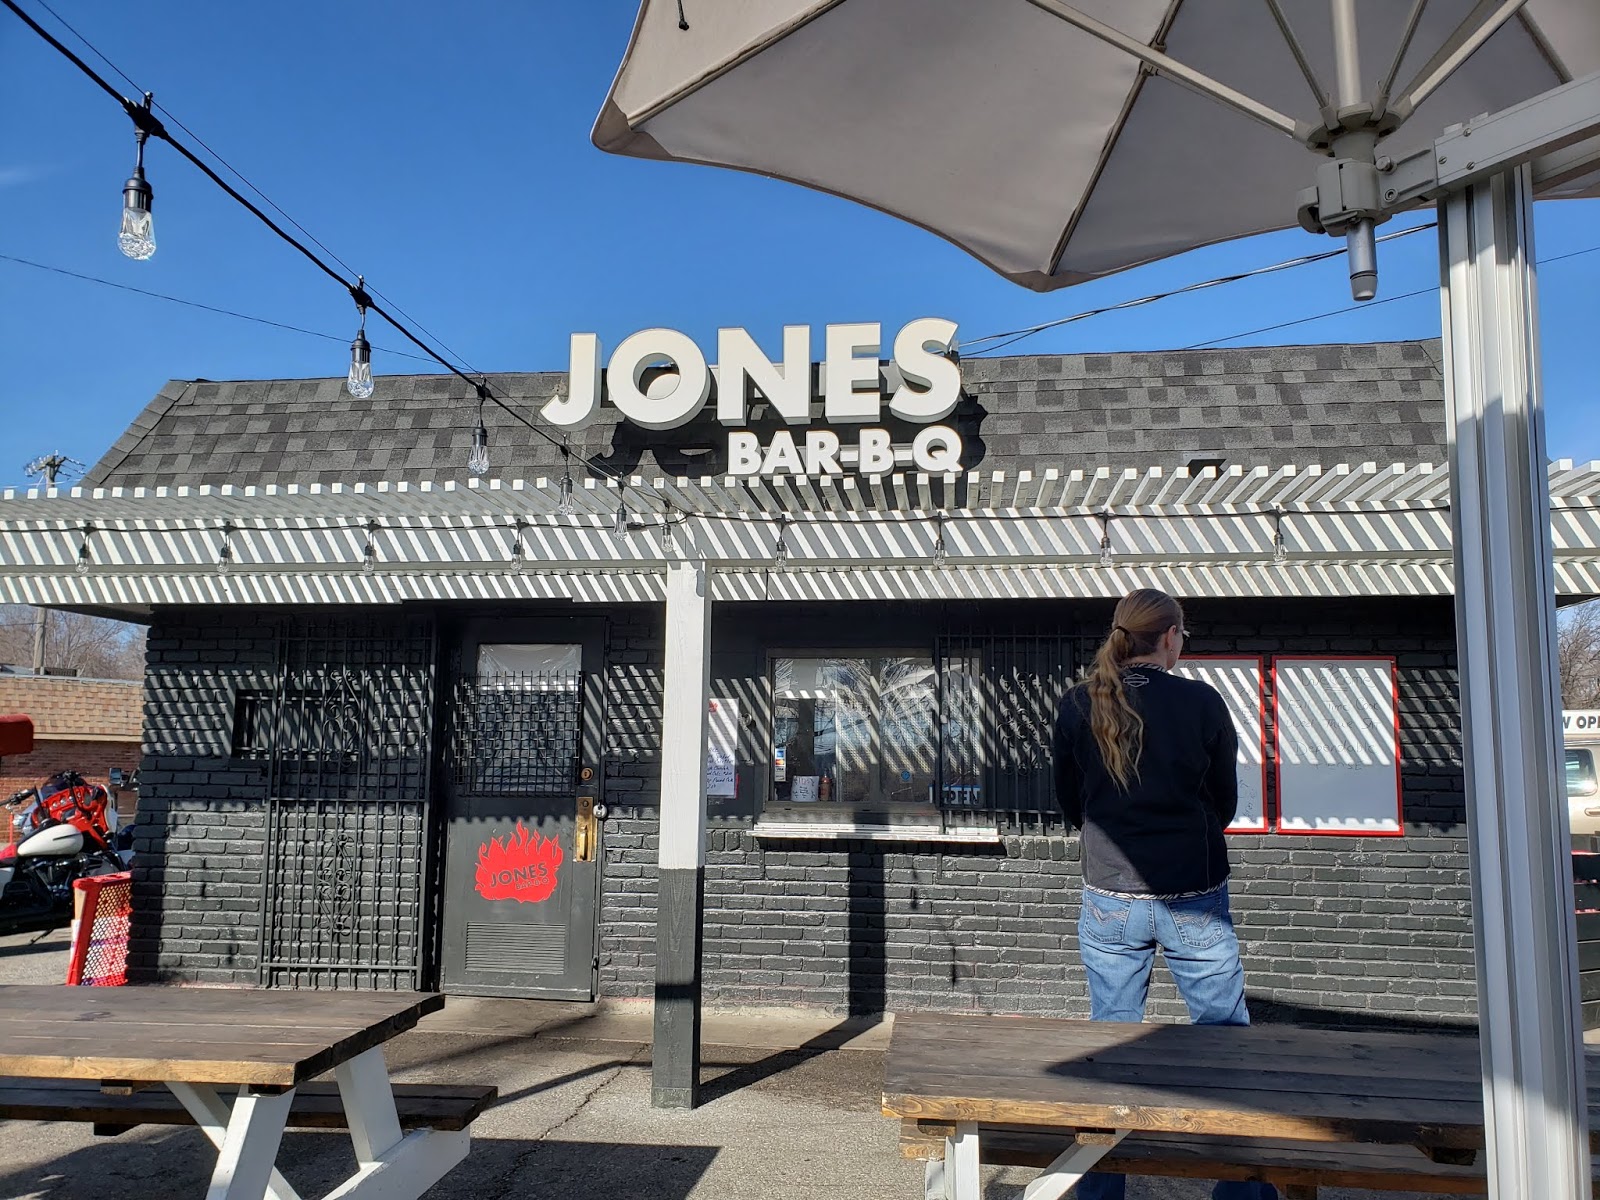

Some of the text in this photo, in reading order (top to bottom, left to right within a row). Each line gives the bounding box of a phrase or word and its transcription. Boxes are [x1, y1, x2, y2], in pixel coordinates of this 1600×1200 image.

[540, 317, 962, 430] JONES
[727, 425, 963, 477] BAR-B-Q
[1575, 715, 1600, 730] OP
[491, 863, 547, 886] JONES
